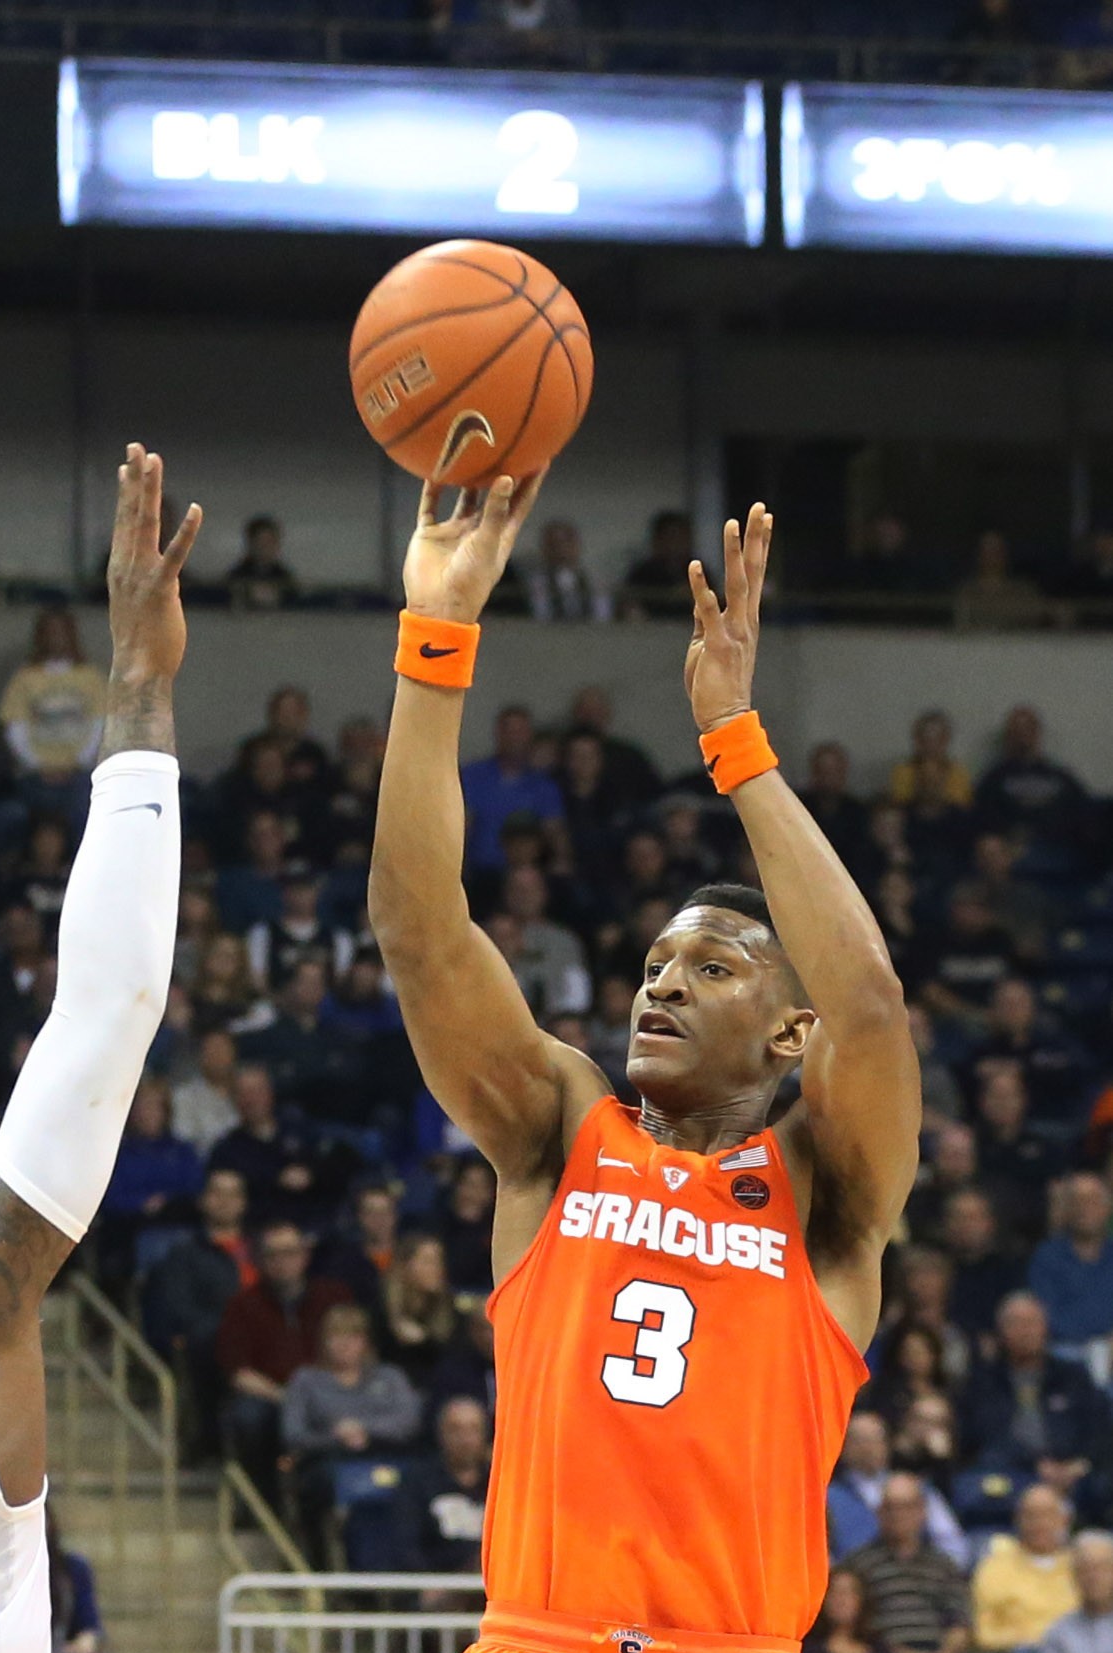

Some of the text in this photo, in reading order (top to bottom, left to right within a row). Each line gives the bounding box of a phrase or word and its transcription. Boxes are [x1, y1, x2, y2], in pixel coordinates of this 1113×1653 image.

[152, 109, 580, 215] BLK 2
[559, 1190, 787, 1279] SYRACUSE
[600, 1279, 696, 1409] 3
